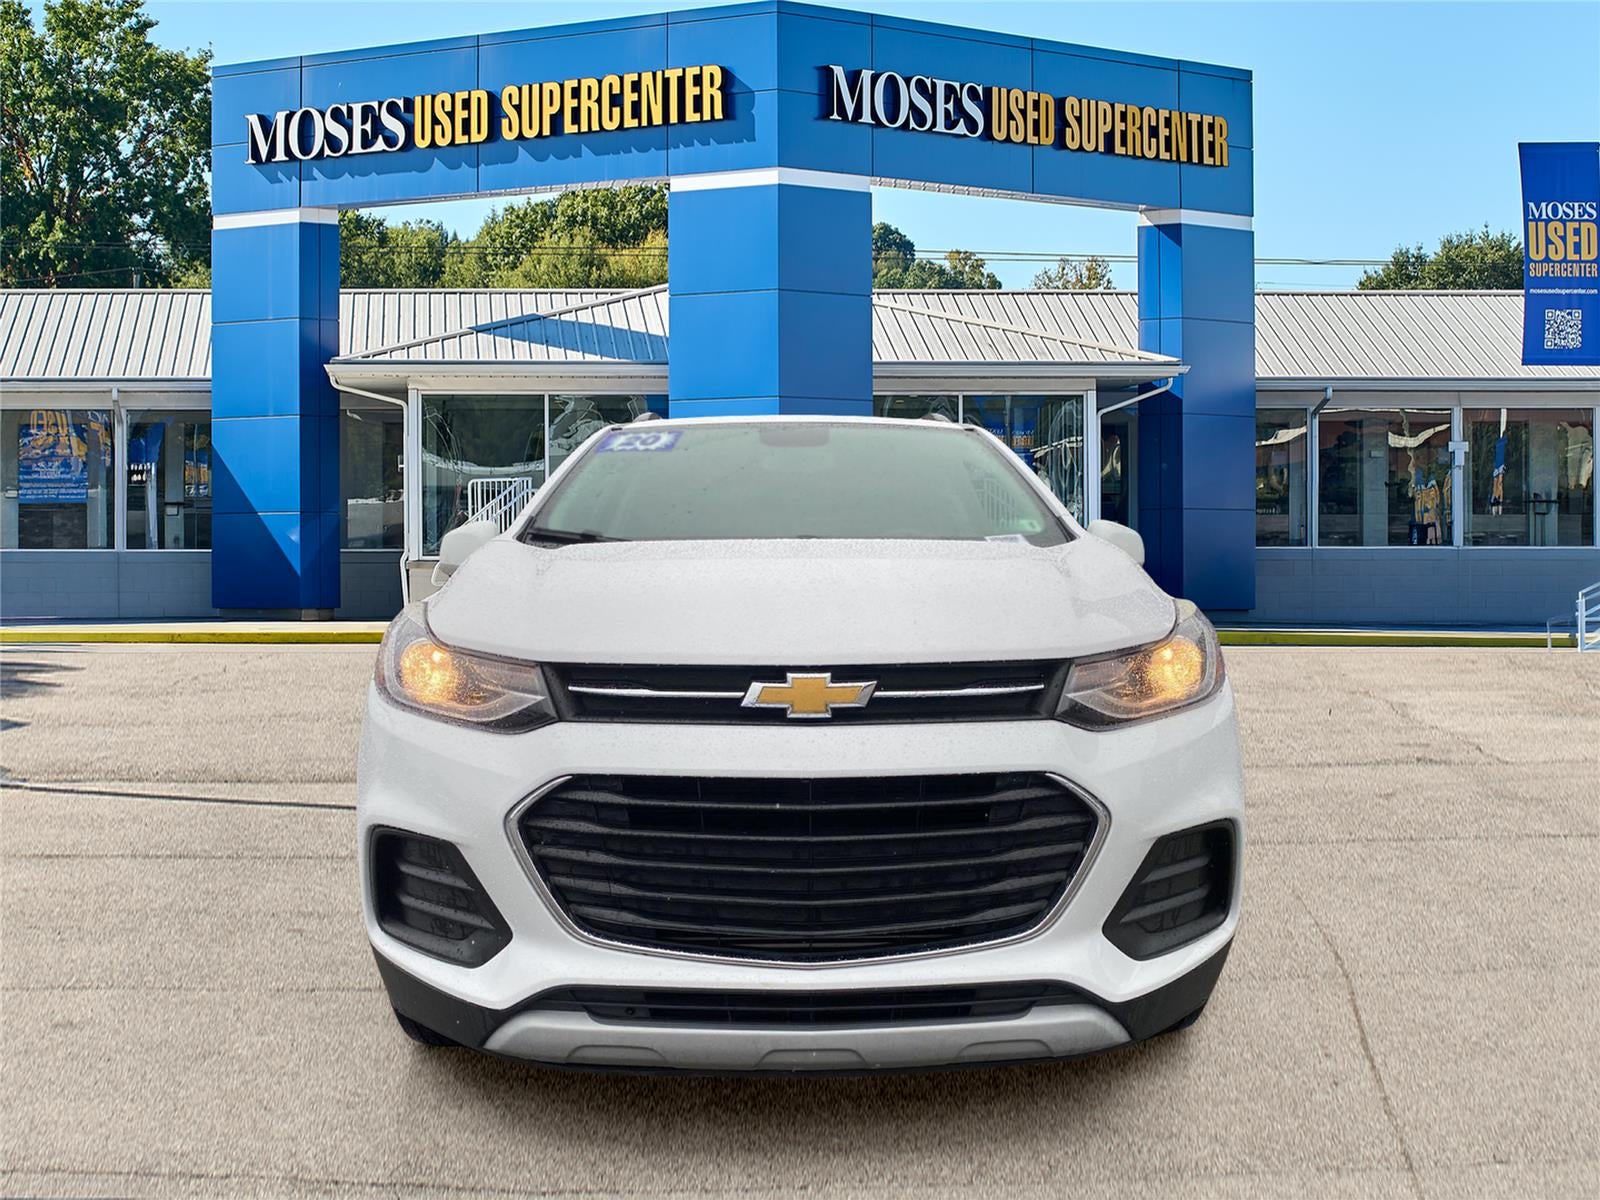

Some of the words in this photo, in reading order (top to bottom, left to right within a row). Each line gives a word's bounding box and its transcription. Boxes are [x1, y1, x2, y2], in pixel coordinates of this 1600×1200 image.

[244, 97, 406, 165] MOSES
[413, 89, 489, 150] USED
[500, 63, 725, 142] SUPERCENTER
[827, 64, 986, 138] MOSES
[990, 85, 1056, 147] USED
[1064, 95, 1230, 168] SUPERCENTER
[1527, 201, 1598, 220] MOSES
[1528, 221, 1599, 261] USED
[1529, 262, 1599, 278] SUPERCENTER
